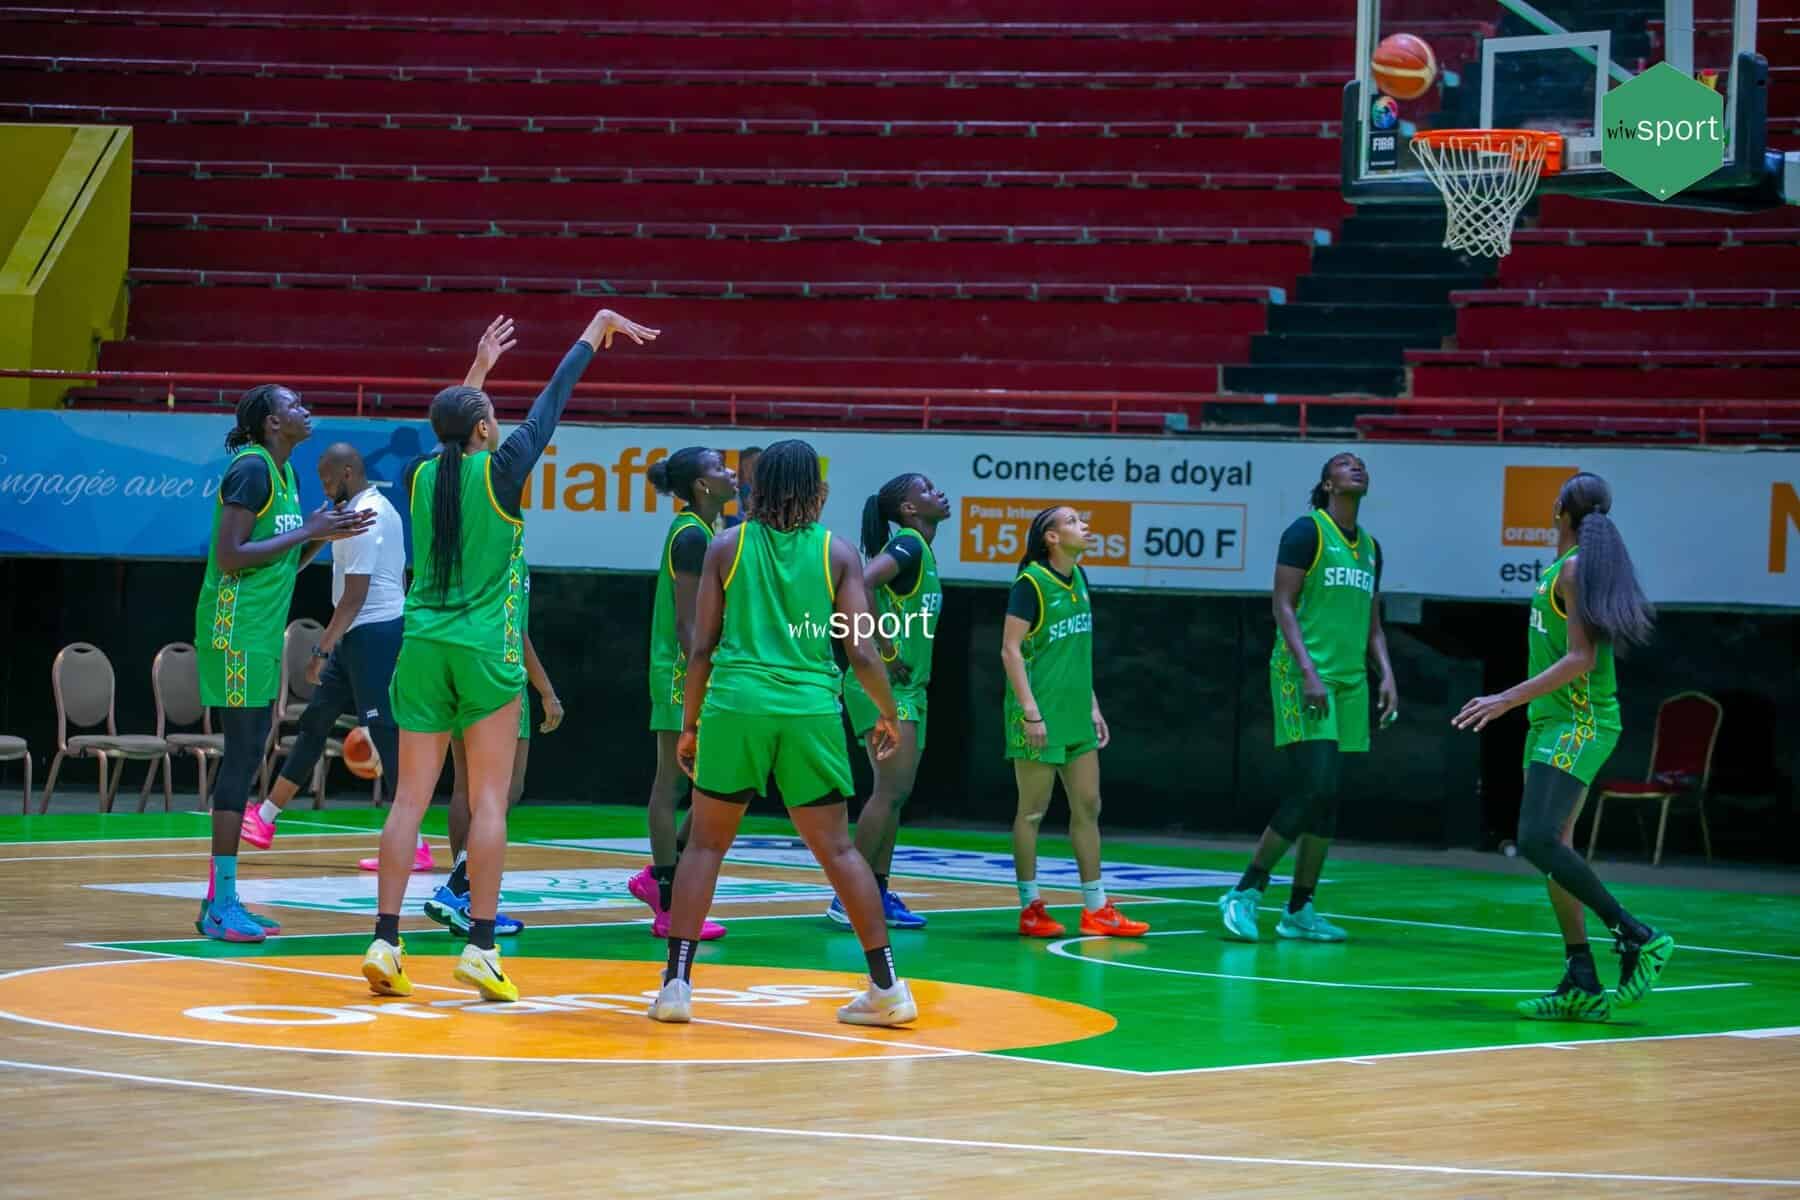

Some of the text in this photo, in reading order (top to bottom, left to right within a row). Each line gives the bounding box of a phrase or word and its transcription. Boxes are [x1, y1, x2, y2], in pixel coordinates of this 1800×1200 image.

[1372, 137, 1395, 151] FIBA
[0, 469, 118, 505] ngagée
[124, 475, 194, 498] avec
[973, 454, 1252, 492] Connecté ba doyal
[969, 523, 1018, 560] 1,5
[1143, 527, 1237, 559] 500 F
[1505, 527, 1559, 546] orang
